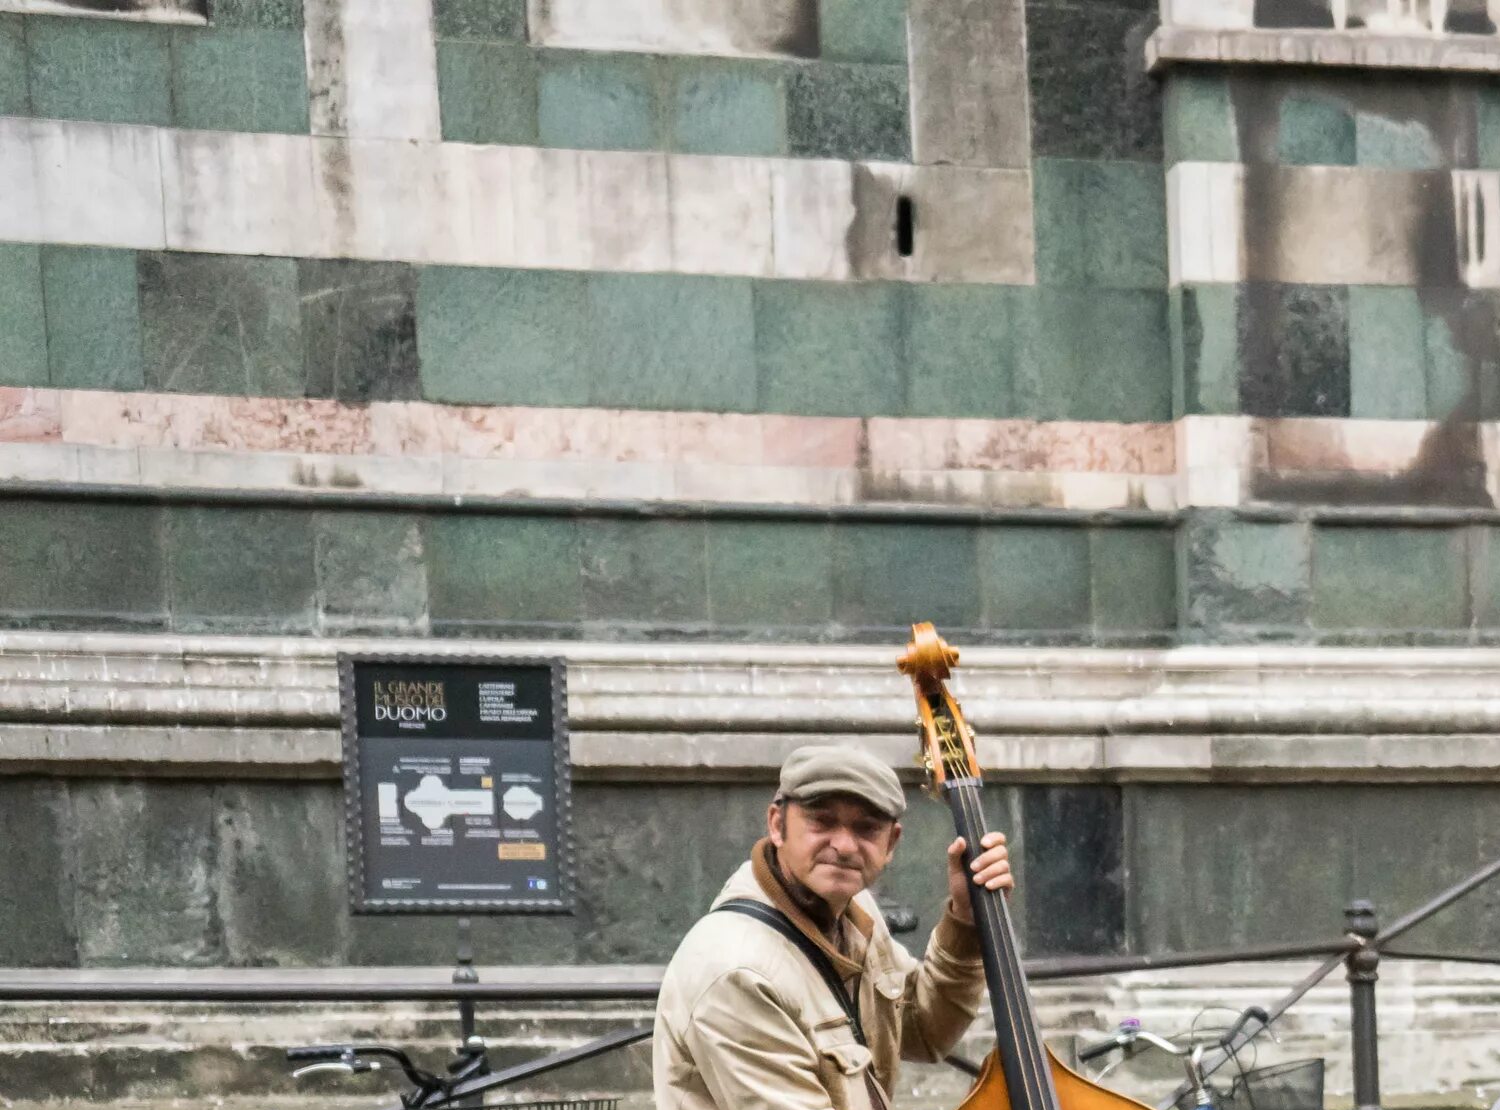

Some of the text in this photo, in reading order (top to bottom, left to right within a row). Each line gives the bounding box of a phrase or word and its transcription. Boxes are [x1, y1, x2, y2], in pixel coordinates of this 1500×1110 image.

[388, 681, 444, 694] GRANDE
[375, 694, 423, 706] MUSEO
[374, 704, 447, 721] DUOMO
